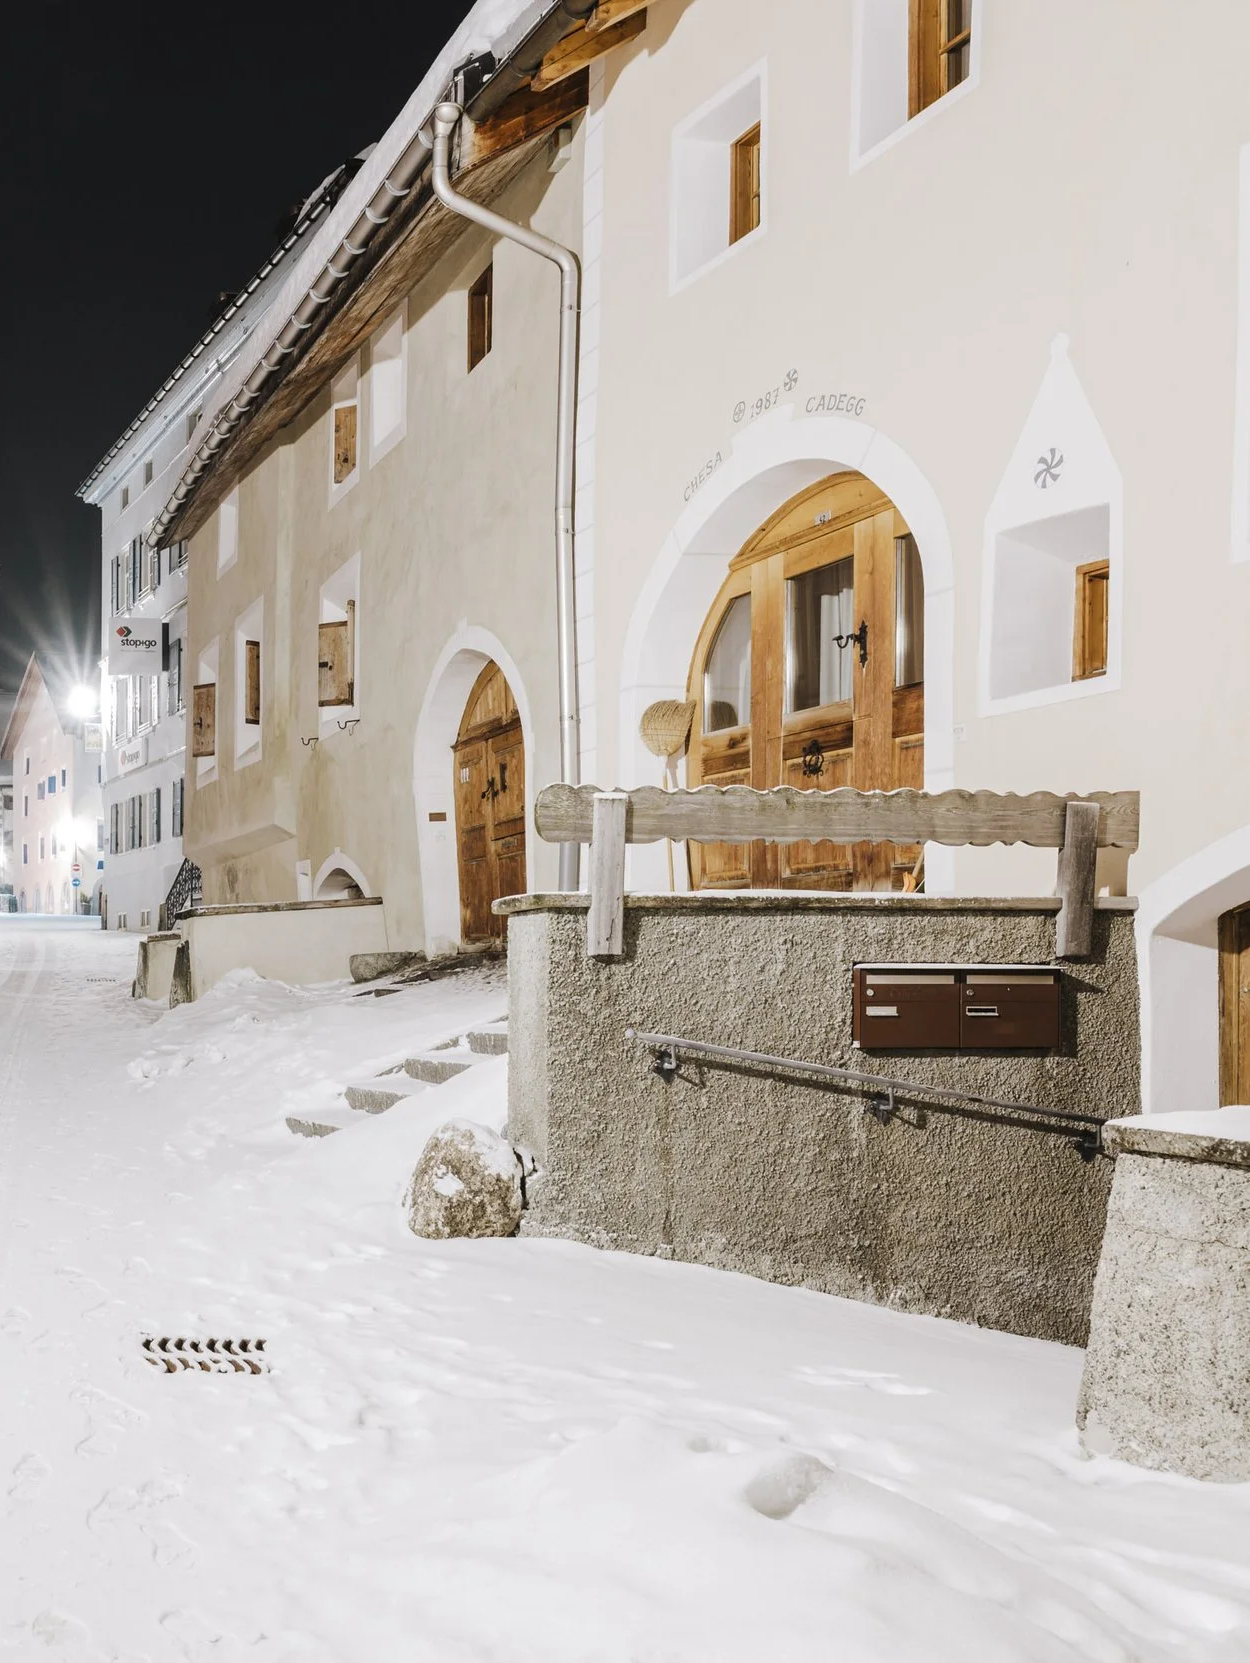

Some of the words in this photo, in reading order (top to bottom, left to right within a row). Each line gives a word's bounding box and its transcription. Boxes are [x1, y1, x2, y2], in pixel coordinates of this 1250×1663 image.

[683, 451, 723, 502] CHESA
[750, 387, 780, 419] 1987
[805, 393, 866, 416] CADEGG
[120, 638, 157, 649] stop+go
